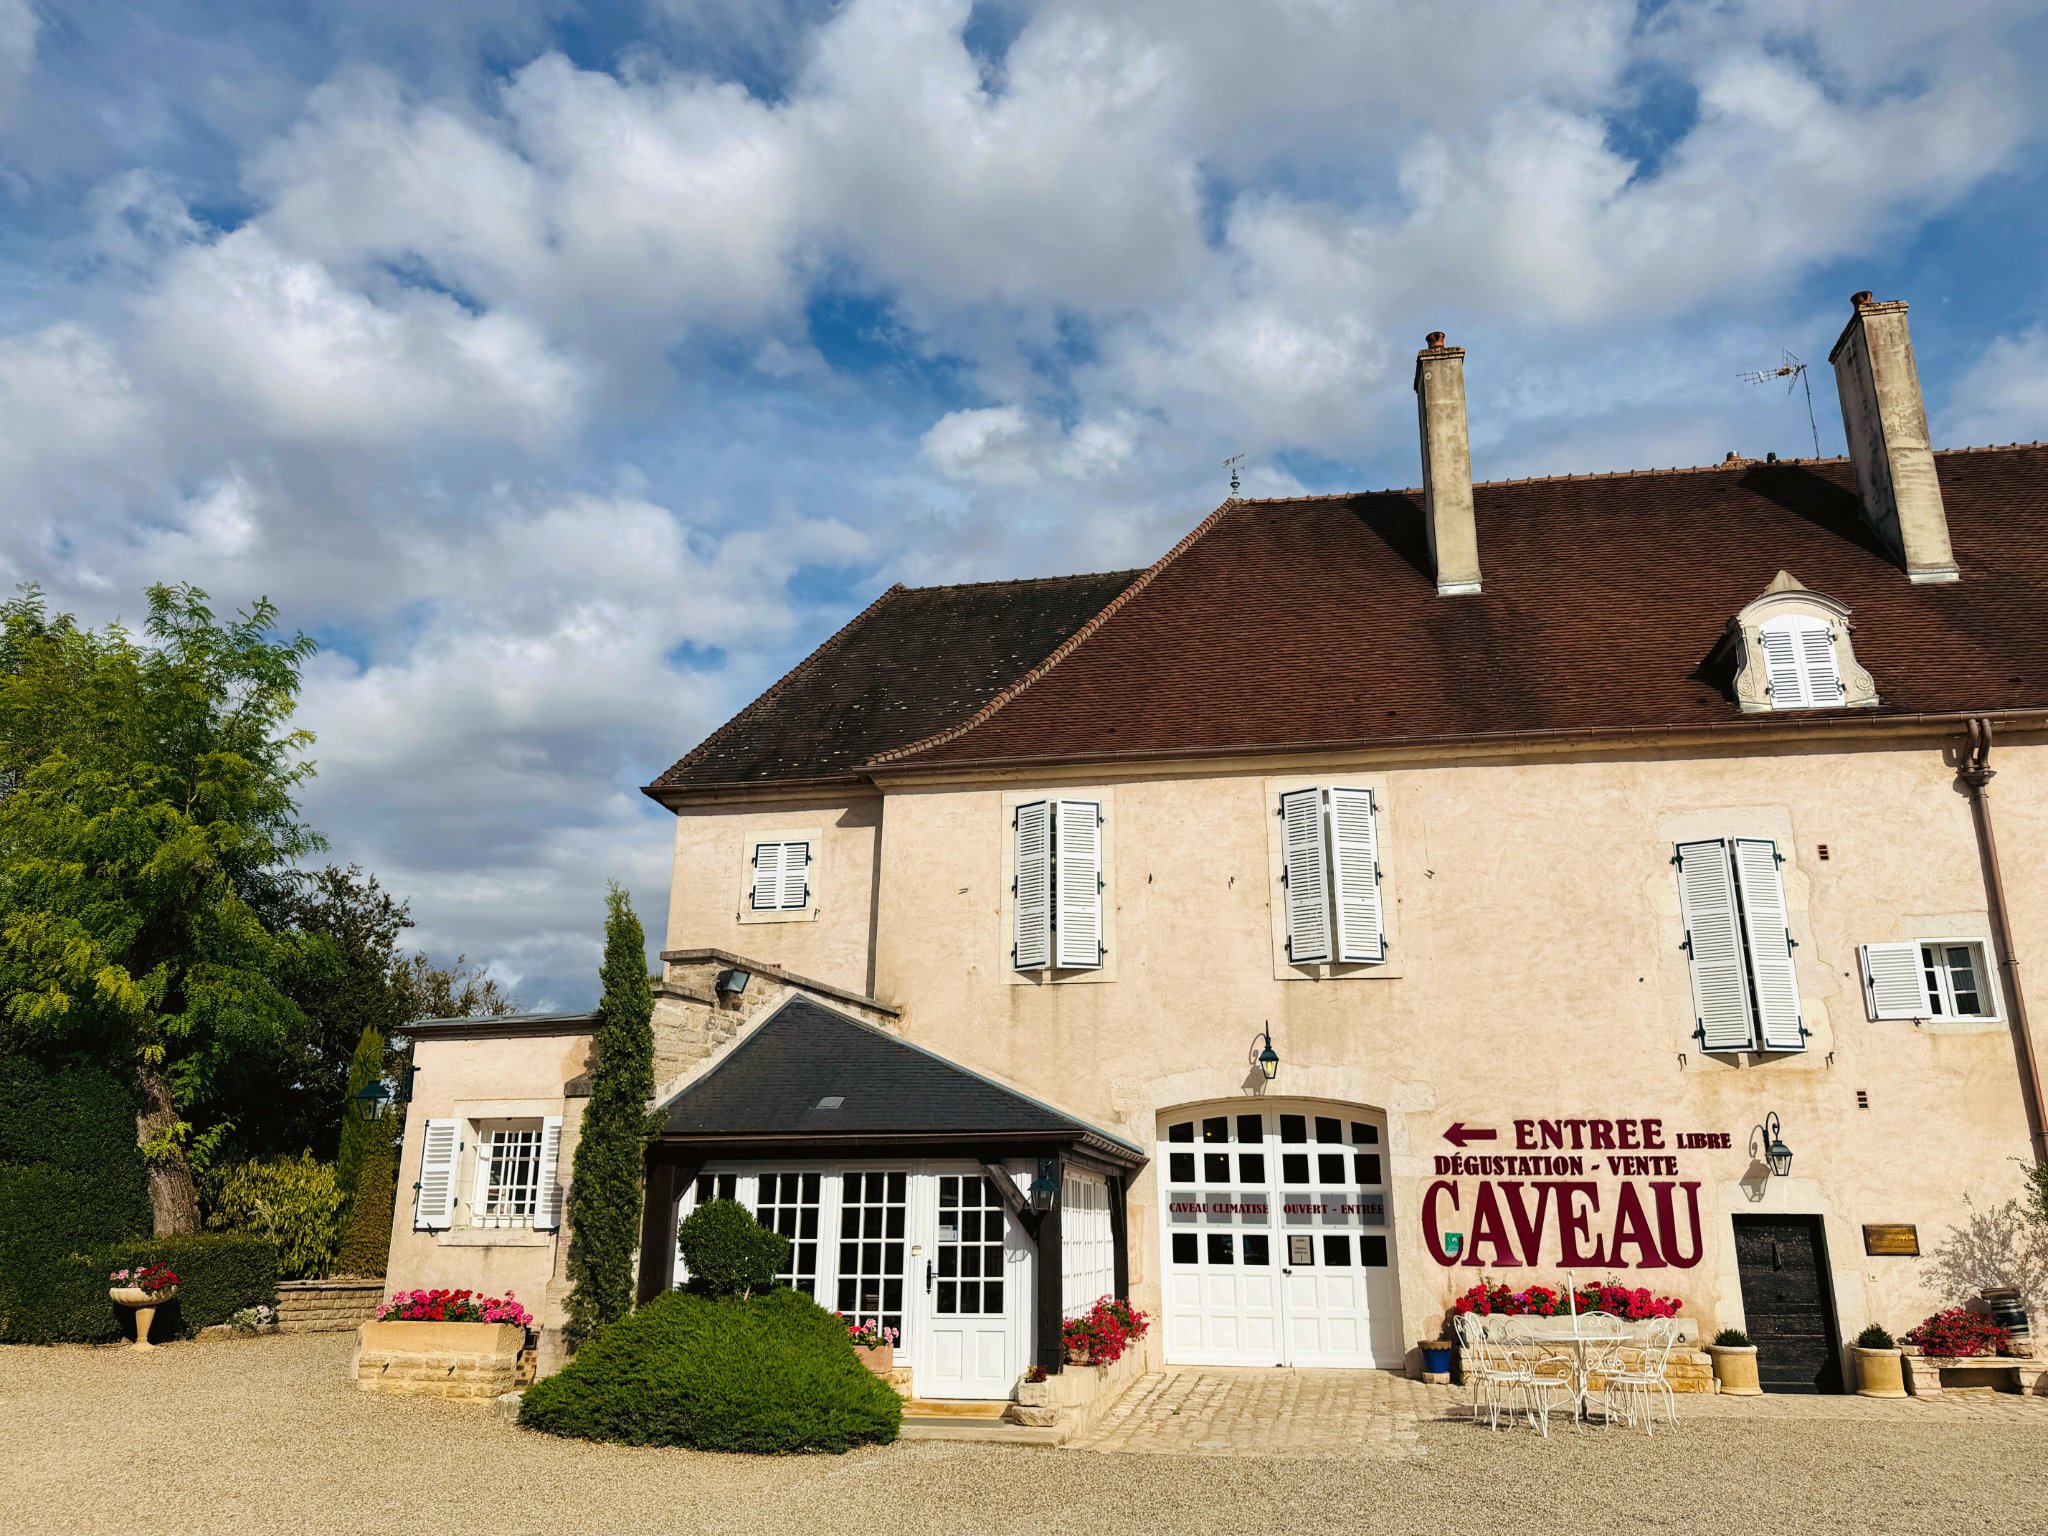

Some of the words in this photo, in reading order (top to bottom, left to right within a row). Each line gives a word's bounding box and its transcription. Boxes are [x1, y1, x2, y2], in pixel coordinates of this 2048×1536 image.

[1514, 1119, 1665, 1150] ENTREE
[1676, 1132, 1732, 1149] LIBRE
[1434, 1152, 1583, 1176] DÉGUSTATION
[1590, 1163, 1600, 1171] -
[1606, 1155, 1678, 1176] VENTE
[1169, 1202, 1209, 1213] CAVEAU
[1212, 1202, 1269, 1214] CLIMATISÉ
[1283, 1203, 1328, 1214] OUVERT
[1341, 1202, 1384, 1214] ENTRÉE
[1421, 1180, 1704, 1269] CAVEAU
